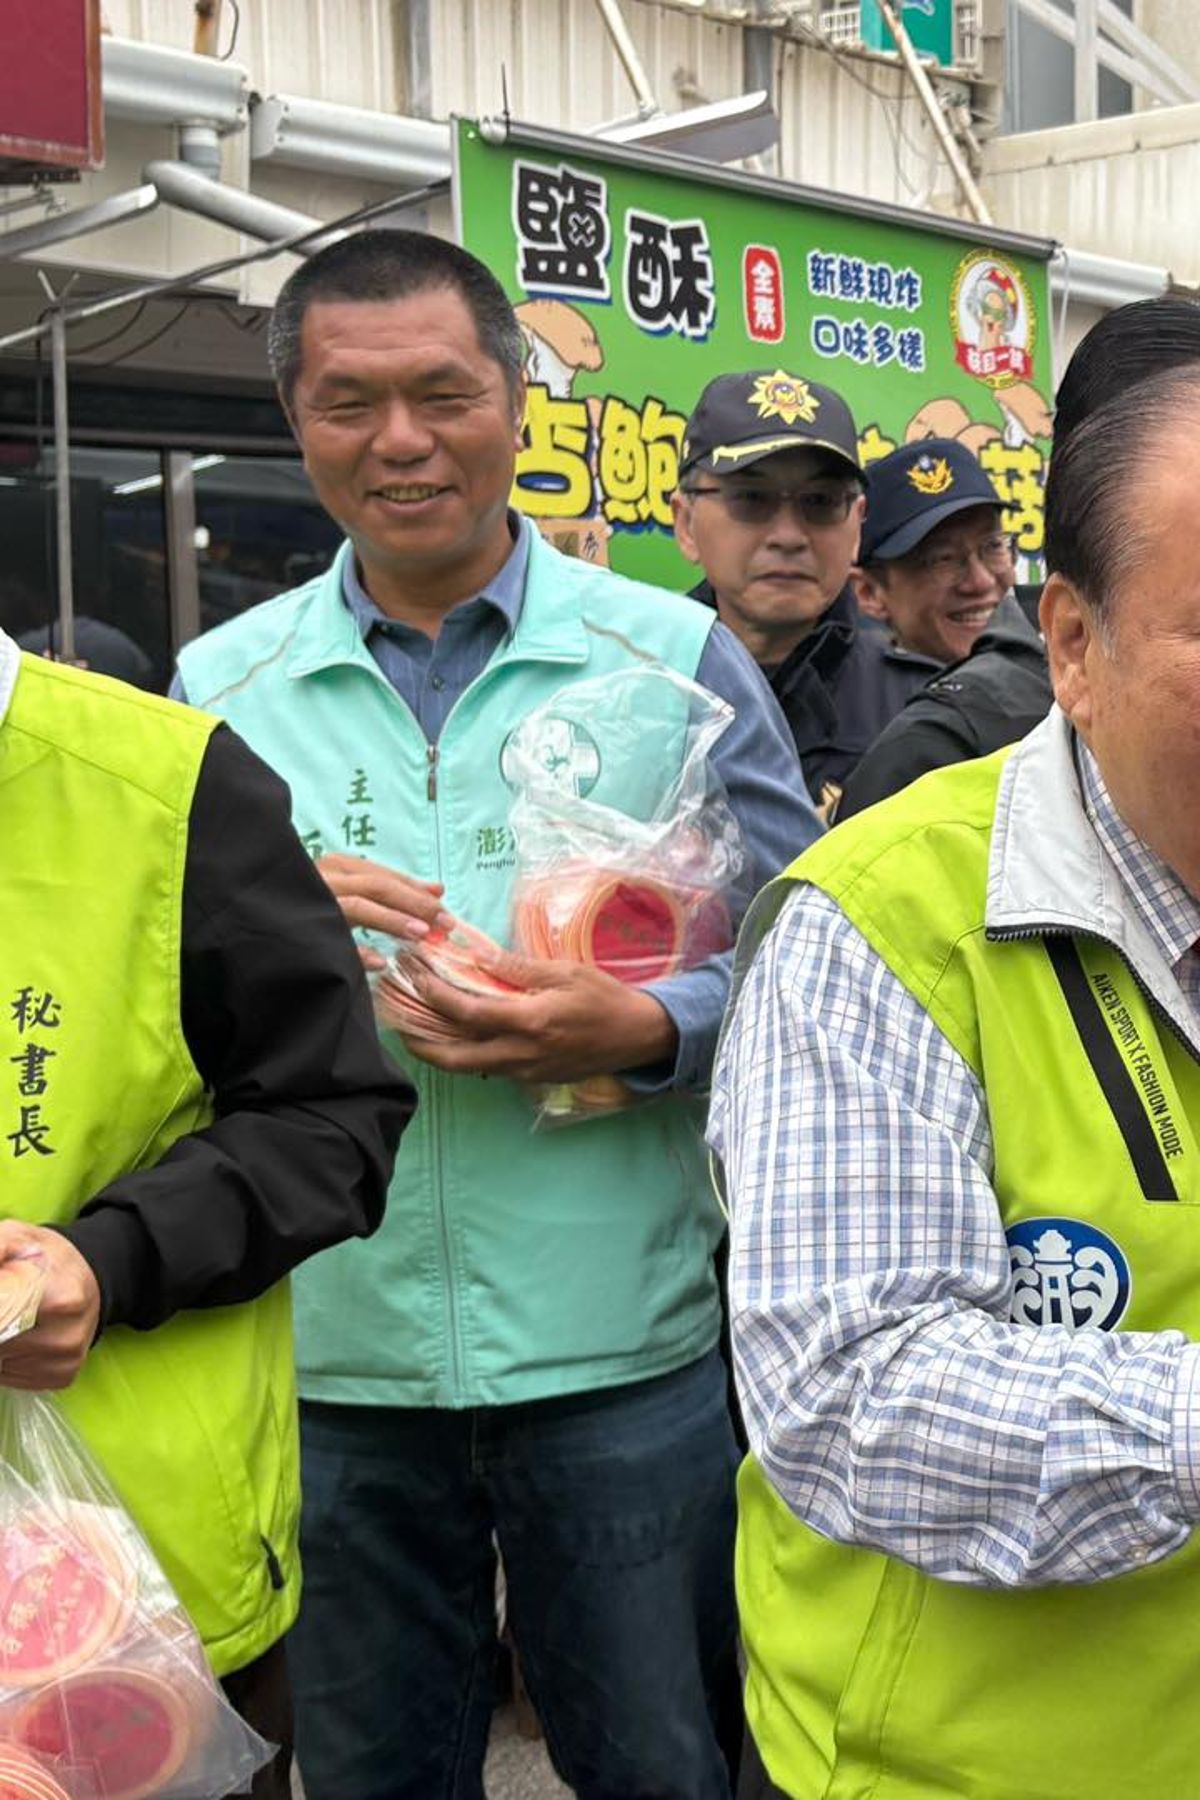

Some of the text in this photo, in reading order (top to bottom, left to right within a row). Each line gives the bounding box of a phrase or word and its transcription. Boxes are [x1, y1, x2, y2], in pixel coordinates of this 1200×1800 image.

[514, 162, 713, 334] 鹽酥
[809, 252, 920, 309] 新鮮現炸
[813, 317, 923, 370] 口味多樣
[476, 826, 515, 857] 澎
[7, 985, 62, 1158] 秘書長
[1091, 972, 1184, 1160] AIKEN SPORT X FASHION MODE
